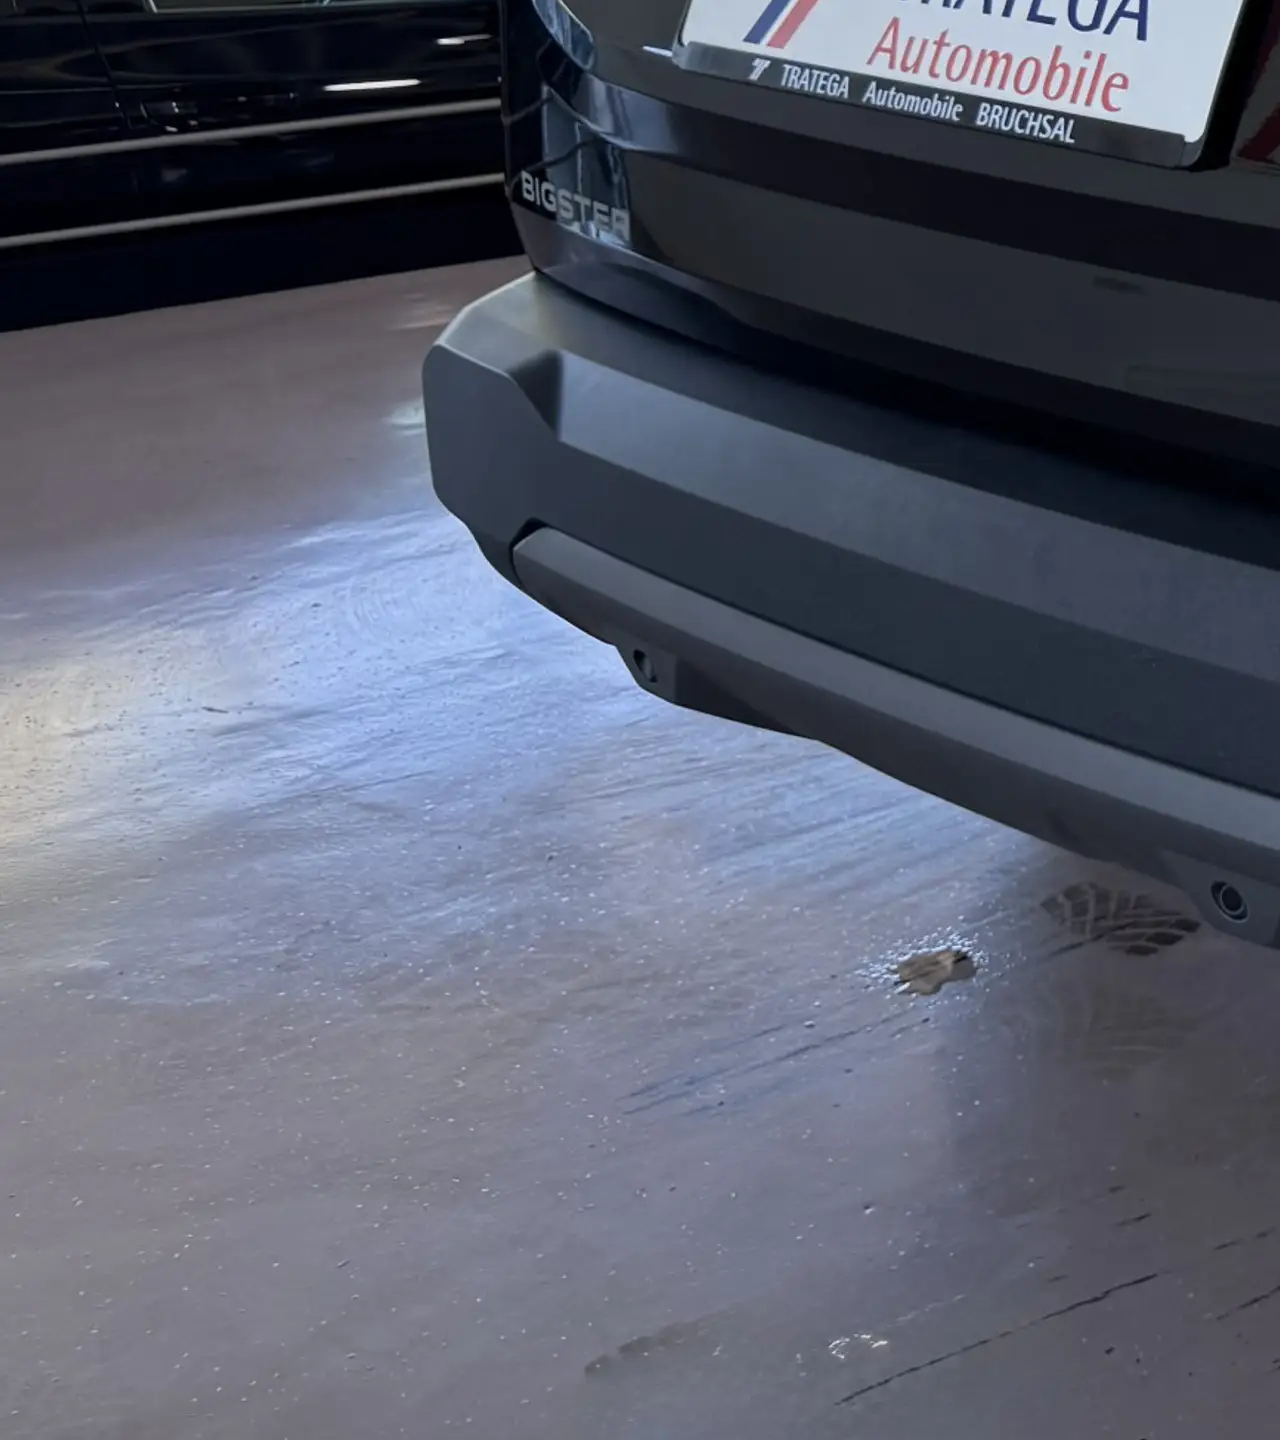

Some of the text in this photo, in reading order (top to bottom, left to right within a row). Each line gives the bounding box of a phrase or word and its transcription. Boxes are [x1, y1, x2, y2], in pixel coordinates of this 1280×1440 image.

[779, 63, 1077, 144] TRATEGA Automobile BRUCHSAL
[866, 16, 1129, 113] Automobile
[520, 169, 631, 241] BIGSTER
